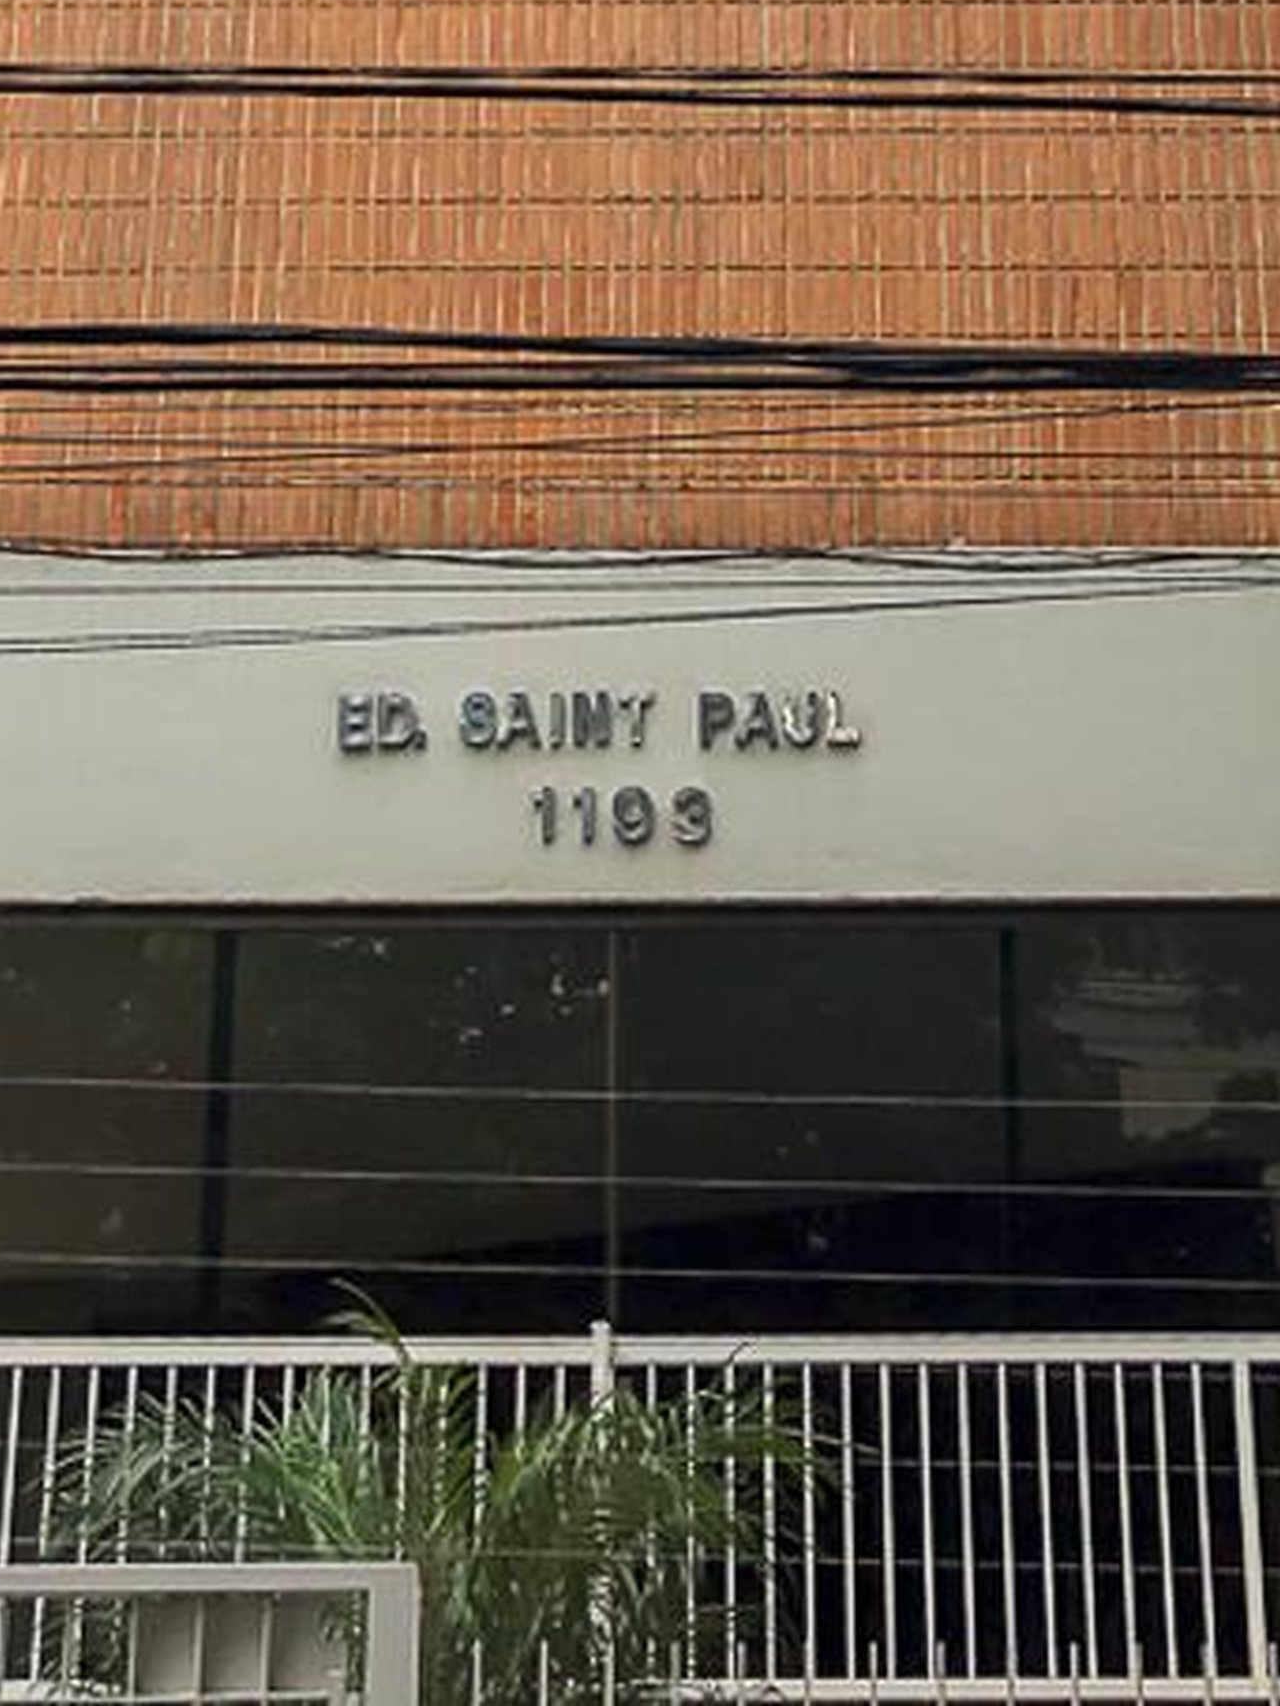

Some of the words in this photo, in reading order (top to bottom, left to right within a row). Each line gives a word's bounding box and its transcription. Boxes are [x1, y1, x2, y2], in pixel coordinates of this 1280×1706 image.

[337, 692, 427, 751] ED.
[459, 690, 657, 749] SAINT
[698, 690, 862, 750] PAUL
[533, 786, 713, 846] 1193
